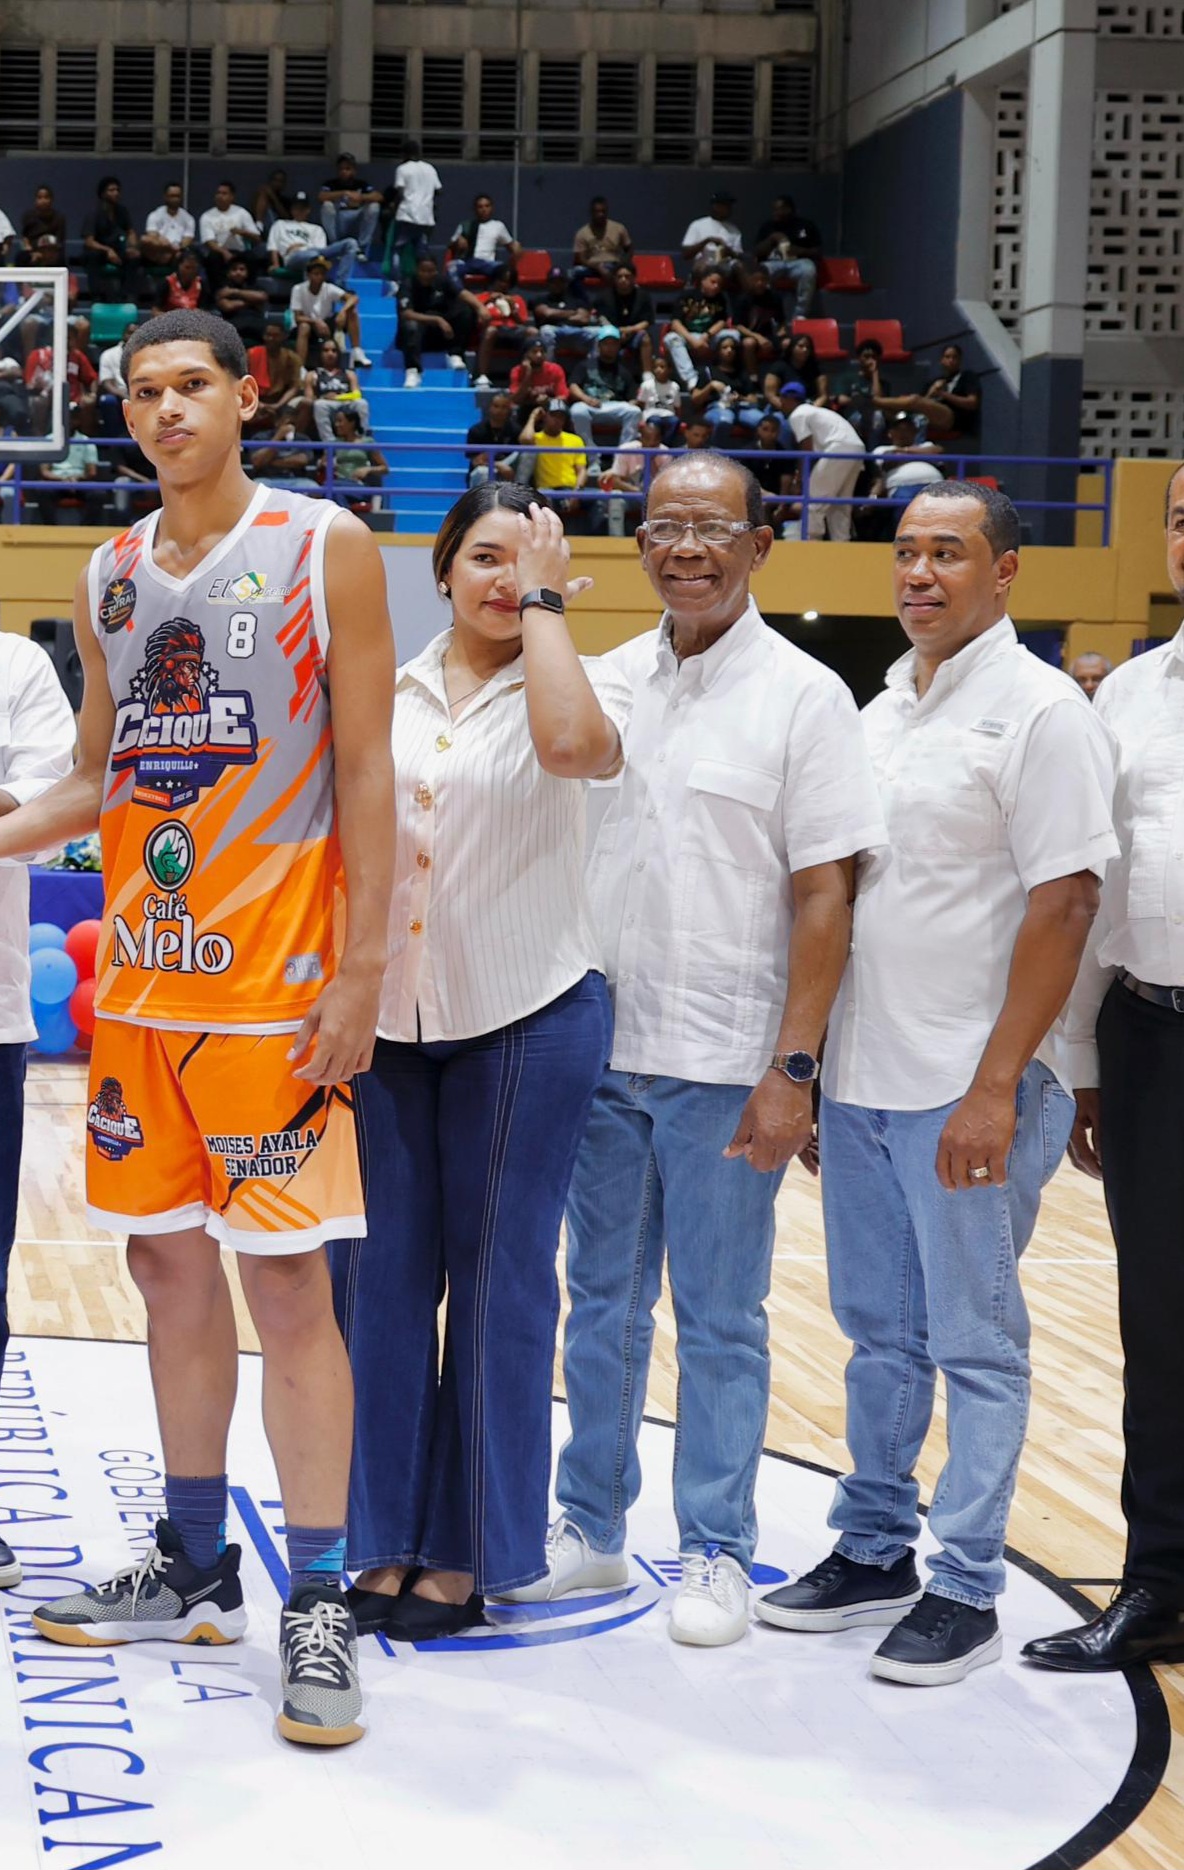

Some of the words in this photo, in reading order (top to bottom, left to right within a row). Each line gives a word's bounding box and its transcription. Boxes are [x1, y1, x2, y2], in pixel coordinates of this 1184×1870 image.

[208, 578, 231, 598] El
[226, 611, 258, 659] 8
[139, 760, 194, 772] ENRIQUILLO
[143, 892, 187, 920] Café
[112, 914, 234, 975] Melo
[88, 1103, 142, 1140] CACIQUE
[205, 1136, 254, 1154] MOISES
[260, 1129, 318, 1154] AYALA
[225, 1155, 298, 1177] SENADOR
[170, 1660, 253, 1703] LA
